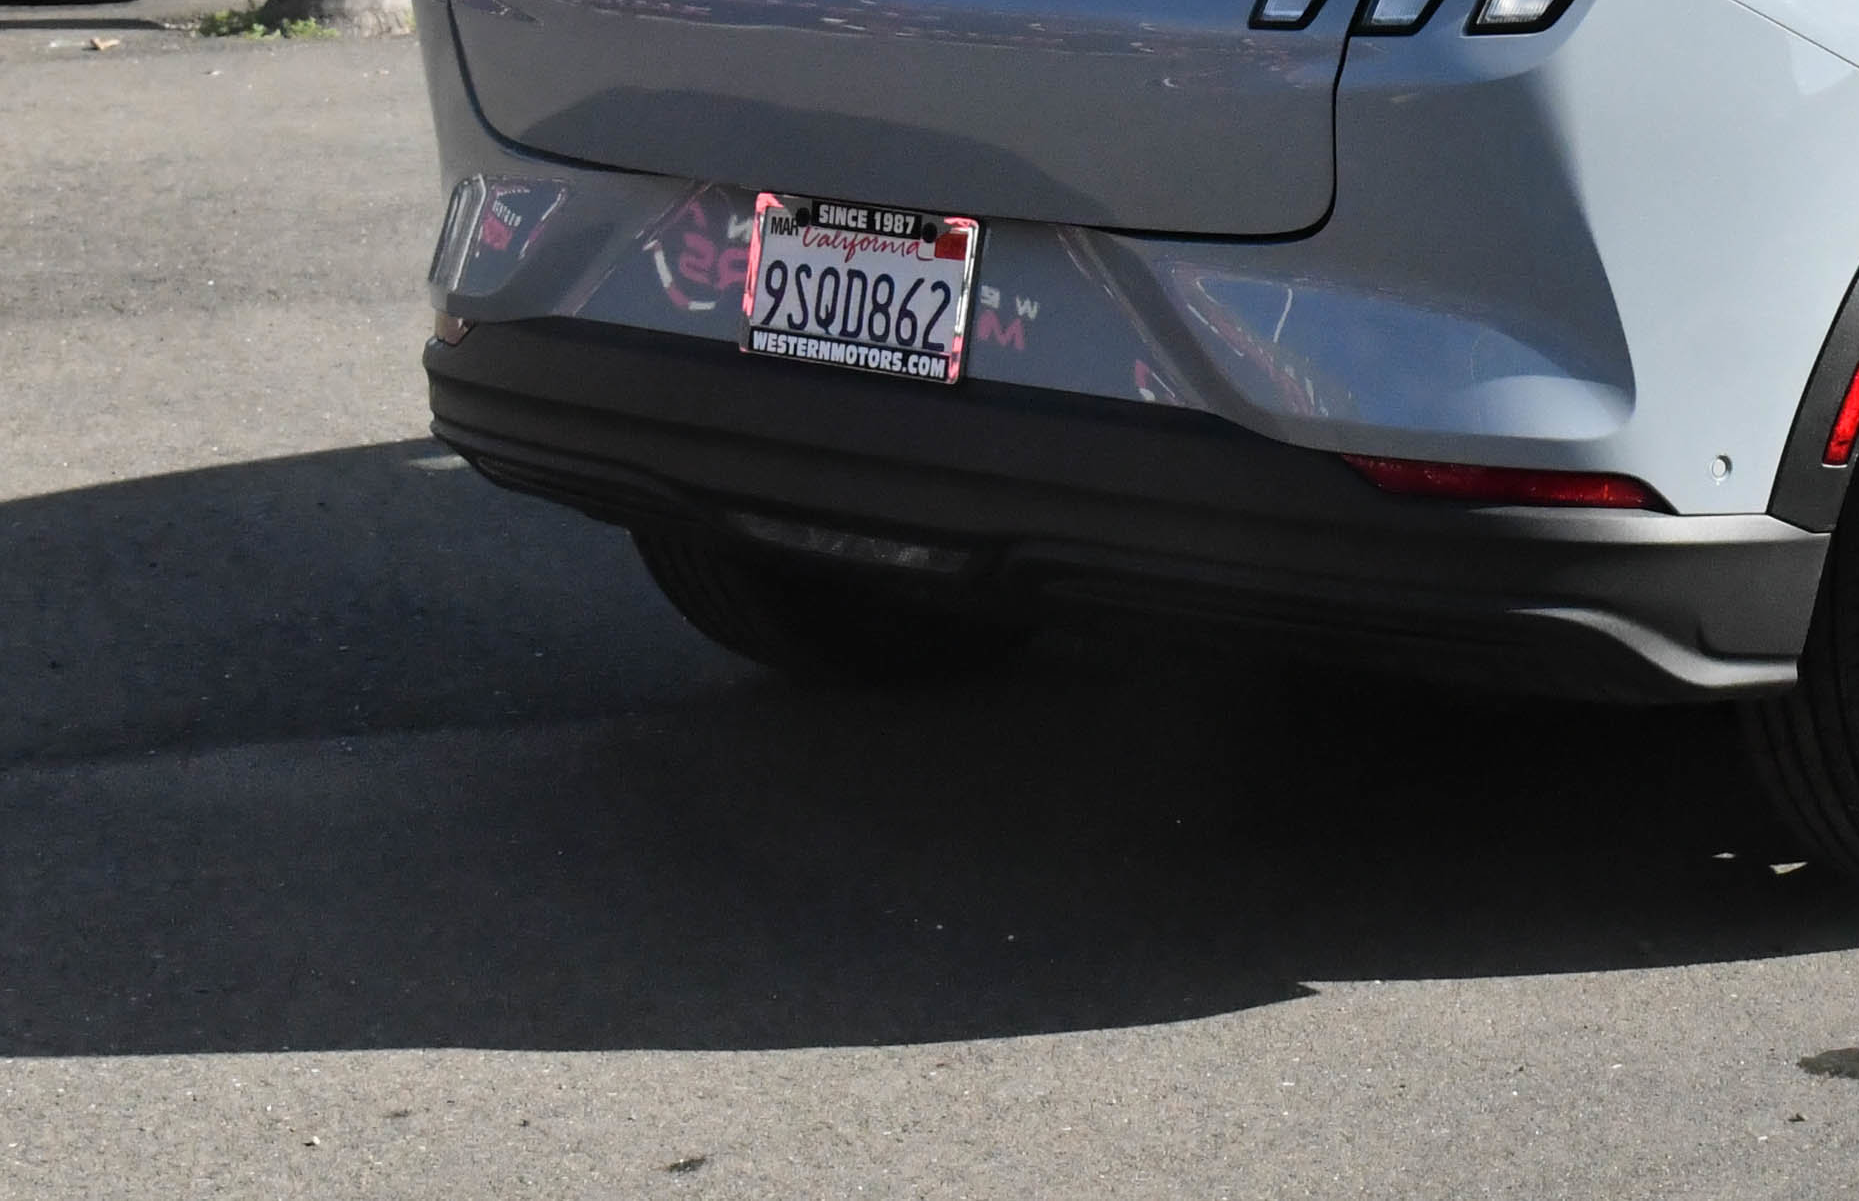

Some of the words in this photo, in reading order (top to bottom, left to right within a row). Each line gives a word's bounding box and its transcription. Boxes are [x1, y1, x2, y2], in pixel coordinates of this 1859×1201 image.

[770, 216, 799, 237] MAR
[818, 203, 868, 229] SINCE
[874, 212, 916, 235] 1987
[803, 226, 934, 264] California
[760, 259, 952, 353] 9SQD862
[752, 330, 946, 379] WESTERNMOTORS.COM
